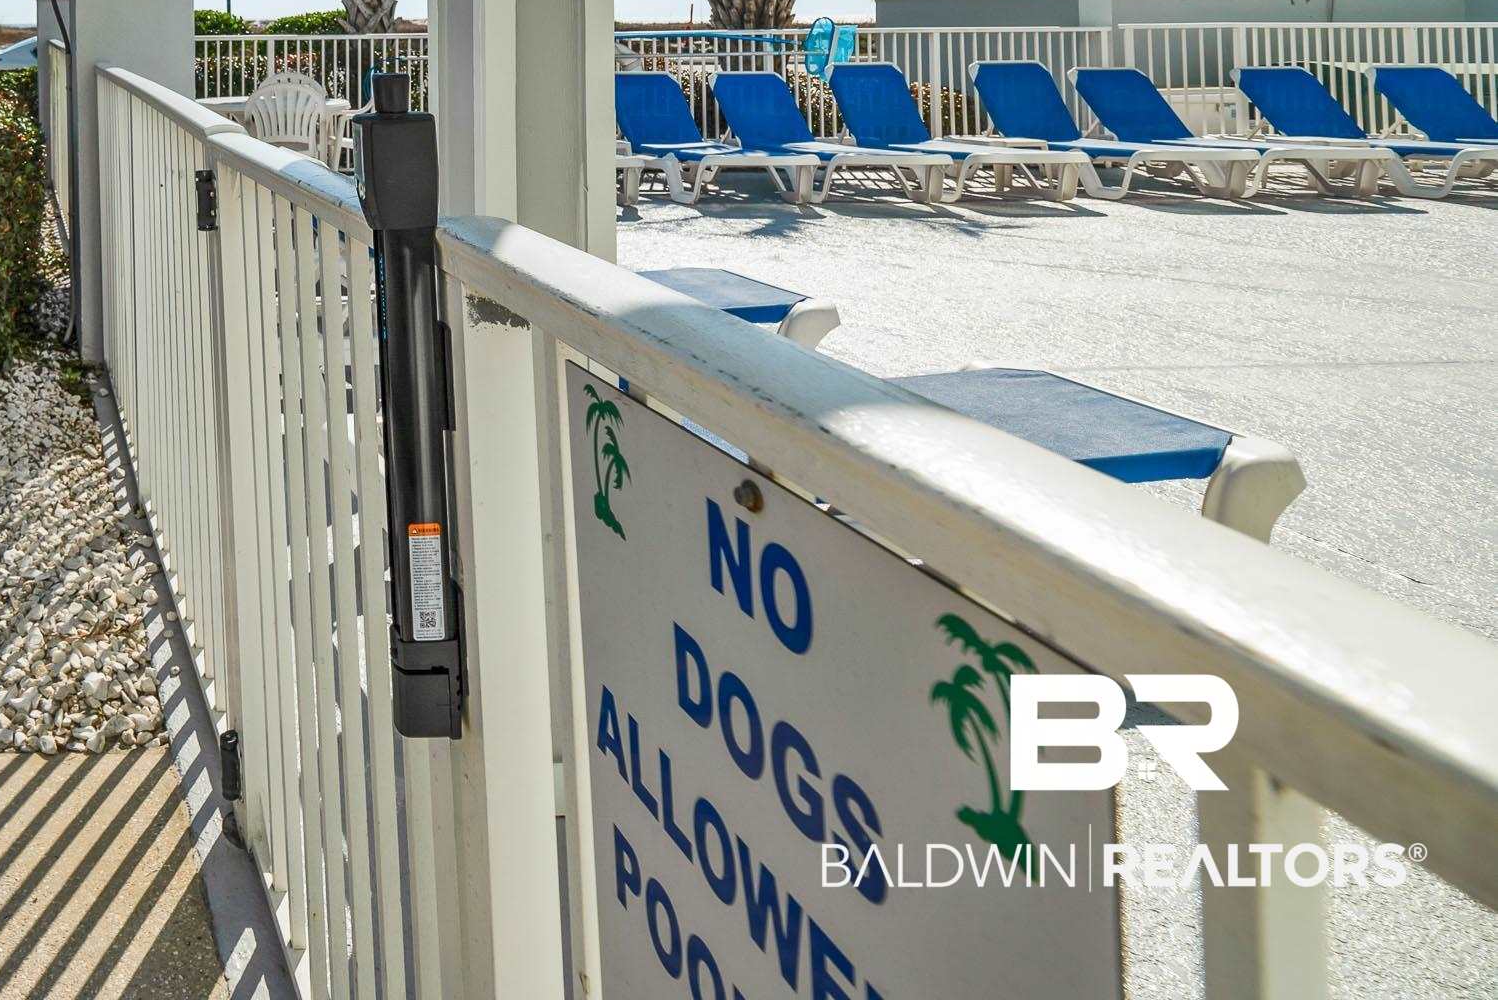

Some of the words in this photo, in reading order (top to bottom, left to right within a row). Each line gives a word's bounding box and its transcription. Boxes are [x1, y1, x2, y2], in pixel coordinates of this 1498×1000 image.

[705, 496, 815, 655] NO
[597, 684, 887, 1000] ALLOWE
[673, 620, 888, 906] DOGS
[613, 823, 747, 1000] POO
